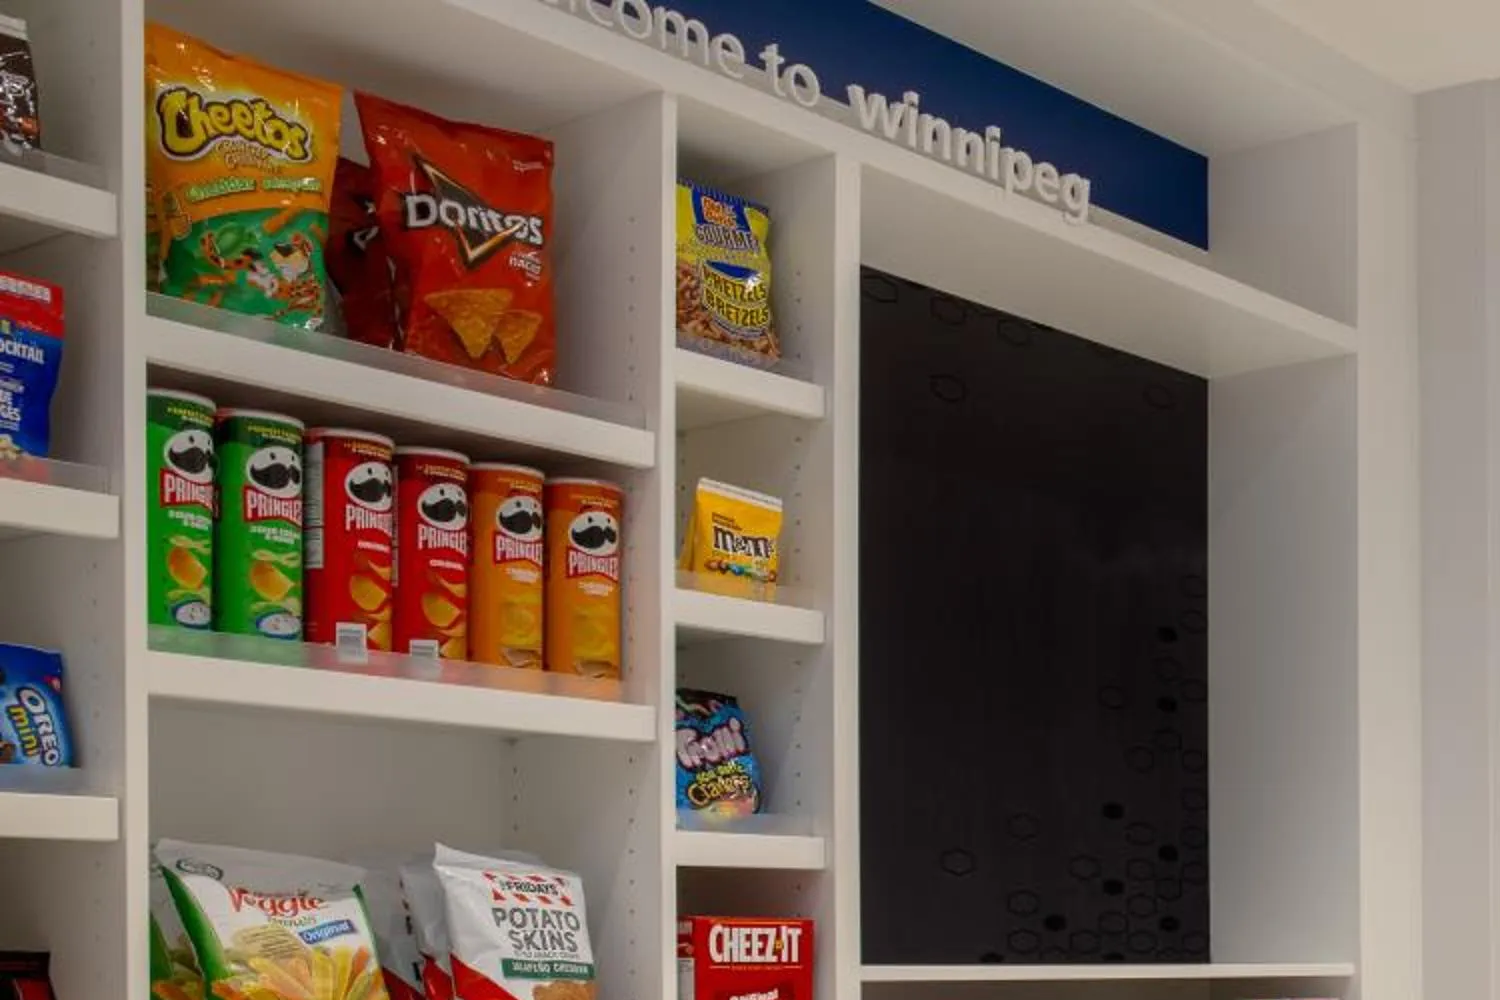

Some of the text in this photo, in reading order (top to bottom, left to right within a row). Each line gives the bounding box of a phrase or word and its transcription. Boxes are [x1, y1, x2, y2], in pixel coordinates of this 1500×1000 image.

[157, 86, 310, 160] Cheetos
[566, 0, 1092, 226] come to winnipeg
[405, 193, 544, 245] Doritos
[492, 907, 581, 933] POTATO
[508, 929, 579, 953] SKINS
